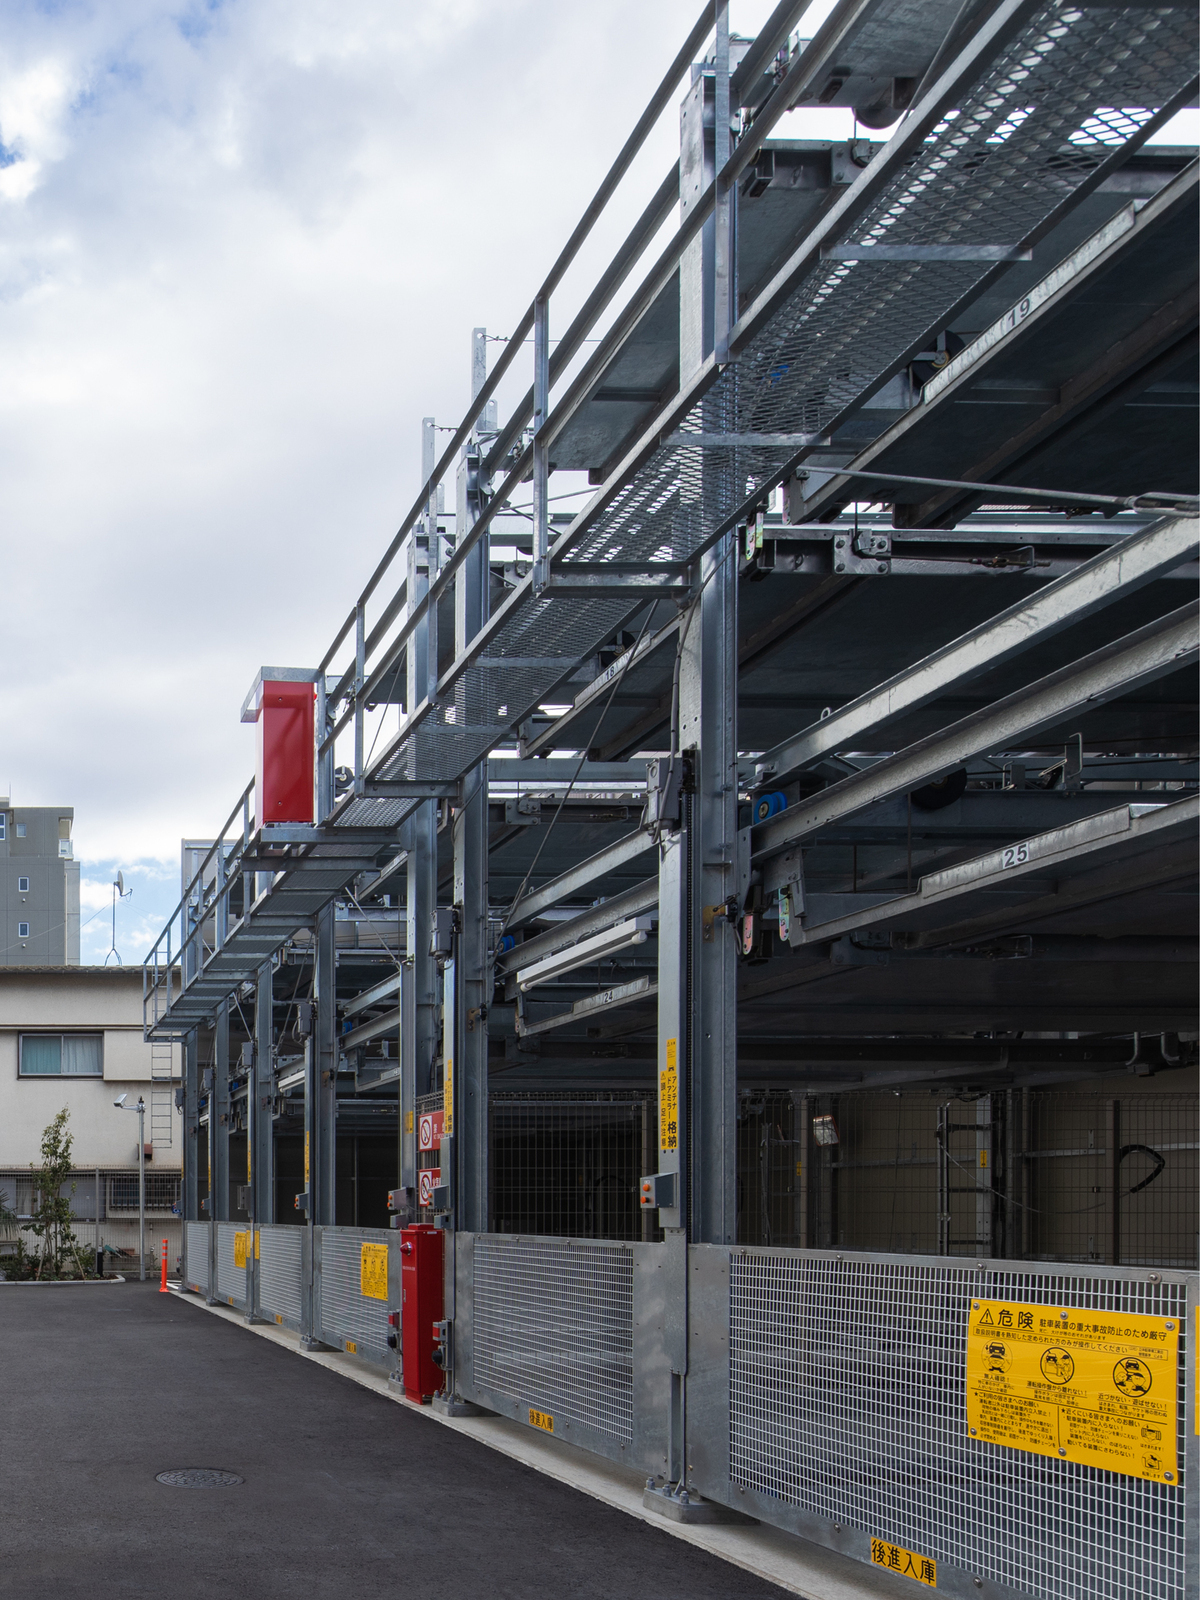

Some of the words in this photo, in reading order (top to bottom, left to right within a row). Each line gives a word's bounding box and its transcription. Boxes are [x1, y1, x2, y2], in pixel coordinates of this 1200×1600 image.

[1007, 297, 1030, 327] 19
[606, 665, 615, 680] 18
[1004, 843, 1027, 867] 25
[604, 990, 613, 1003] 24
[667, 1121, 677, 1148] 格納
[997, 1308, 1034, 1329] 危険
[1039, 1318, 1167, 1341] 駐車装置の重大事故防止のため厳守
[975, 1328, 1128, 1353] 取扱説明書を熟知した定められた方のみが操作してください
[1098, 1392, 1168, 1410] 近づかない・遊ばせない！
[530, 1409, 553, 1431] 後進入庫
[872, 1540, 935, 1584] 後進入庫
